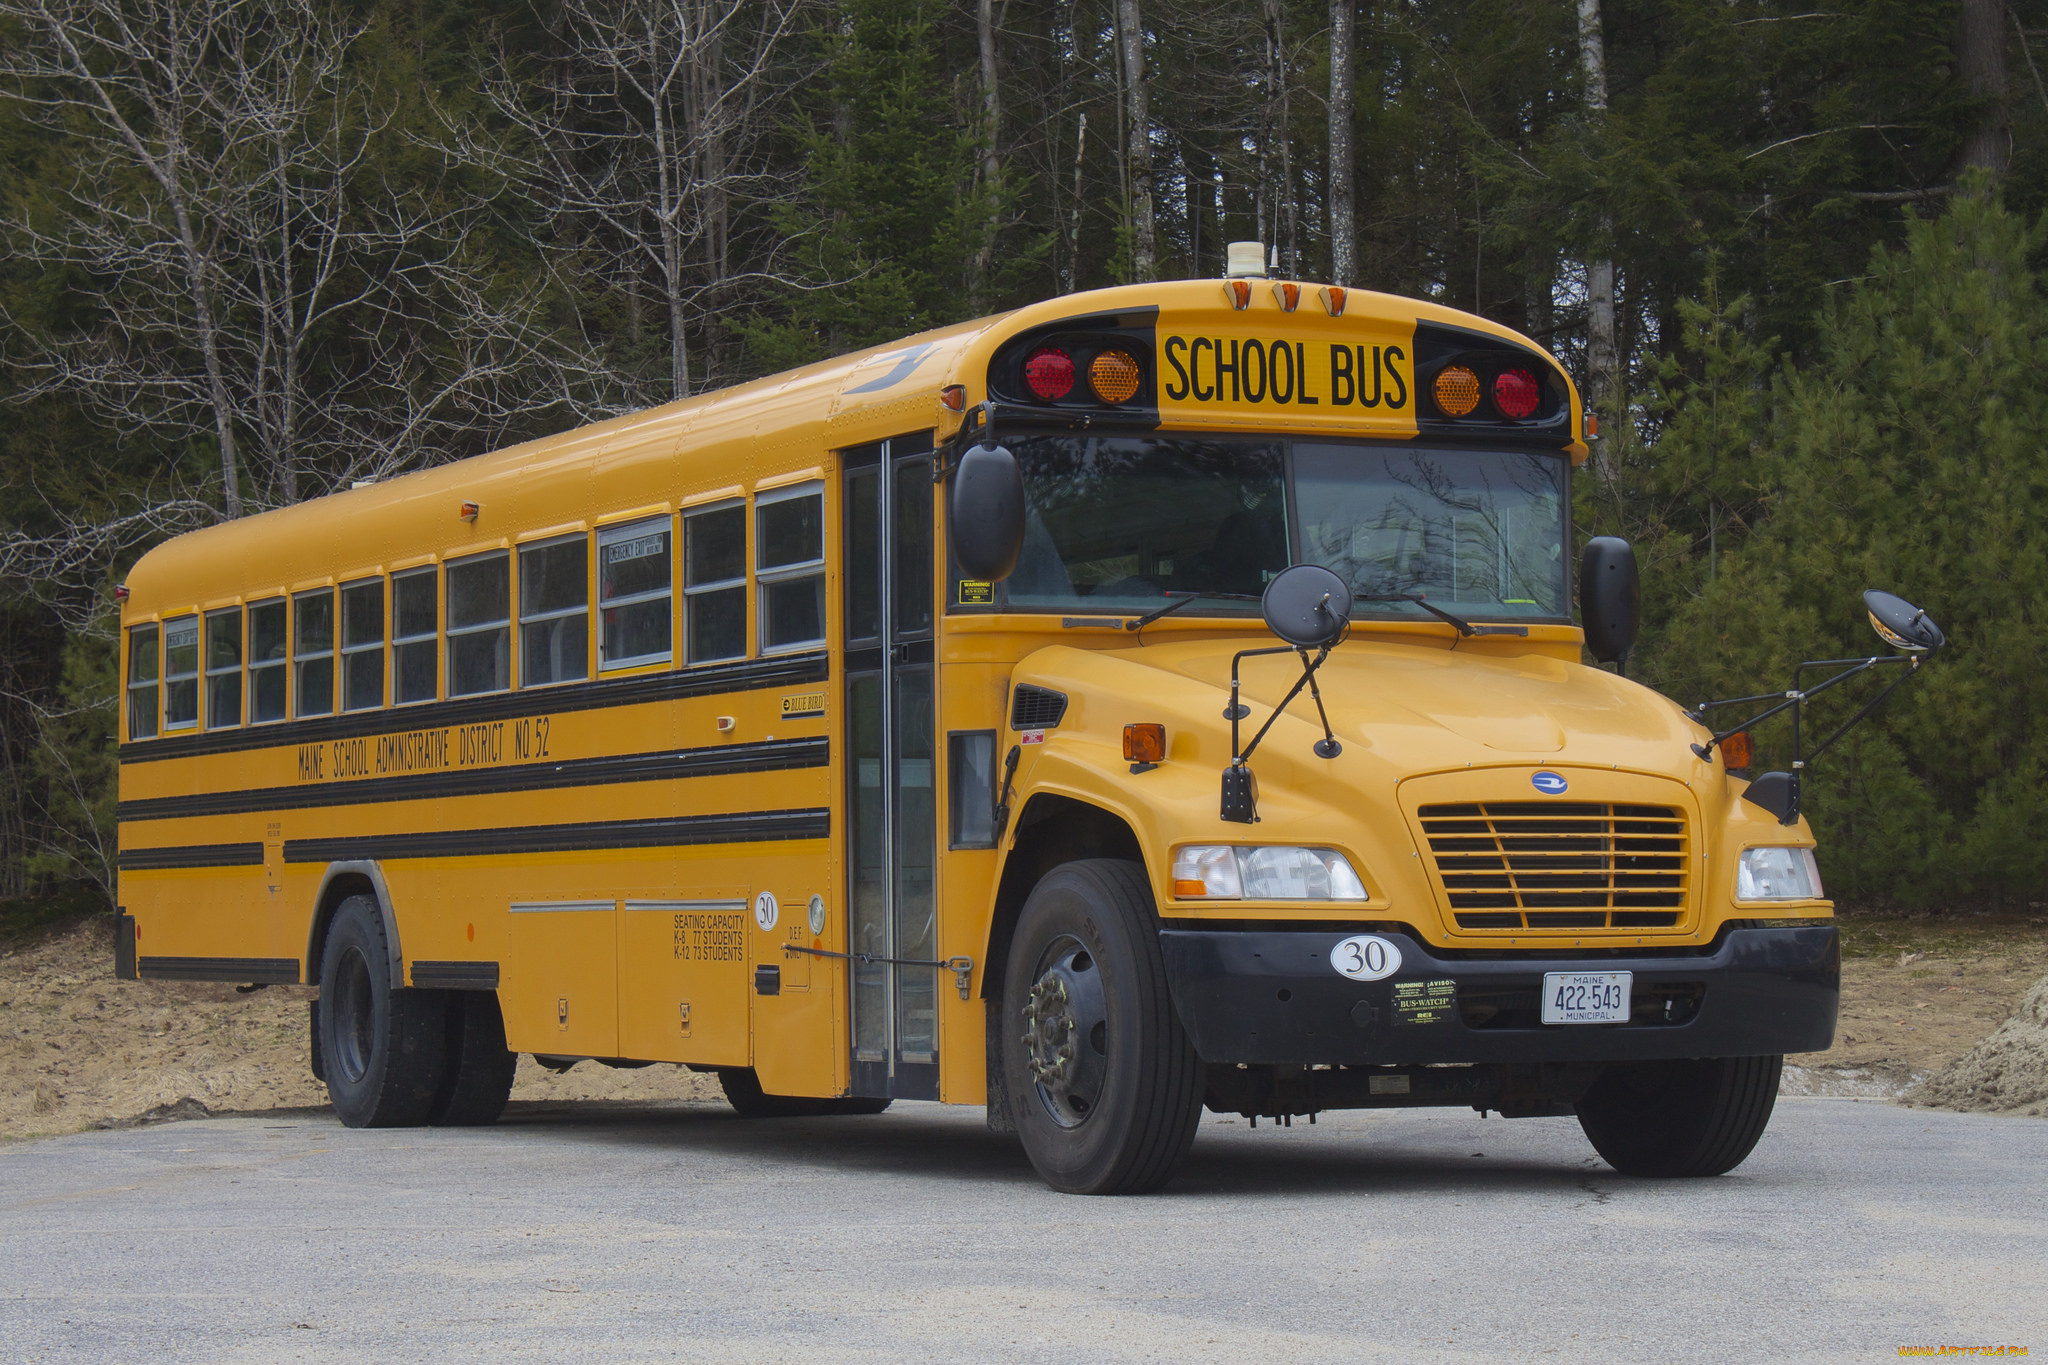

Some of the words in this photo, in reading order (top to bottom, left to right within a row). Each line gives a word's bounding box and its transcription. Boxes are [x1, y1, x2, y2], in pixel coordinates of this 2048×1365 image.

[1164, 335, 1319, 405] SCHOOL
[1330, 343, 1407, 410] BUS
[609, 543, 634, 561] EMERGENCY
[635, 540, 645, 556] EXIT
[791, 696, 807, 711] BLUE
[808, 695, 824, 710] BIRD
[298, 744, 324, 781] MAINE
[333, 739, 369, 778] SCHOOL
[375, 729, 449, 774] ADMINISTRATIVE
[459, 722, 504, 766] DISTRICT
[535, 716, 550, 758] 52
[759, 896, 774, 924] 30
[674, 914, 706, 929] SEATING
[707, 914, 745, 930] CAPACITY
[674, 930, 686, 945] K-8
[693, 930, 702, 945] 77
[703, 930, 743, 946] STUDENTS
[674, 945, 690, 960] K-12
[693, 945, 702, 961] 73
[703, 946, 743, 962] STUDENTS
[1343, 940, 1389, 976] 30
[1394, 981, 1424, 989] WARNING!
[1573, 976, 1604, 984] MAINE
[1566, 1011, 1611, 1021] MUNICIPAL
